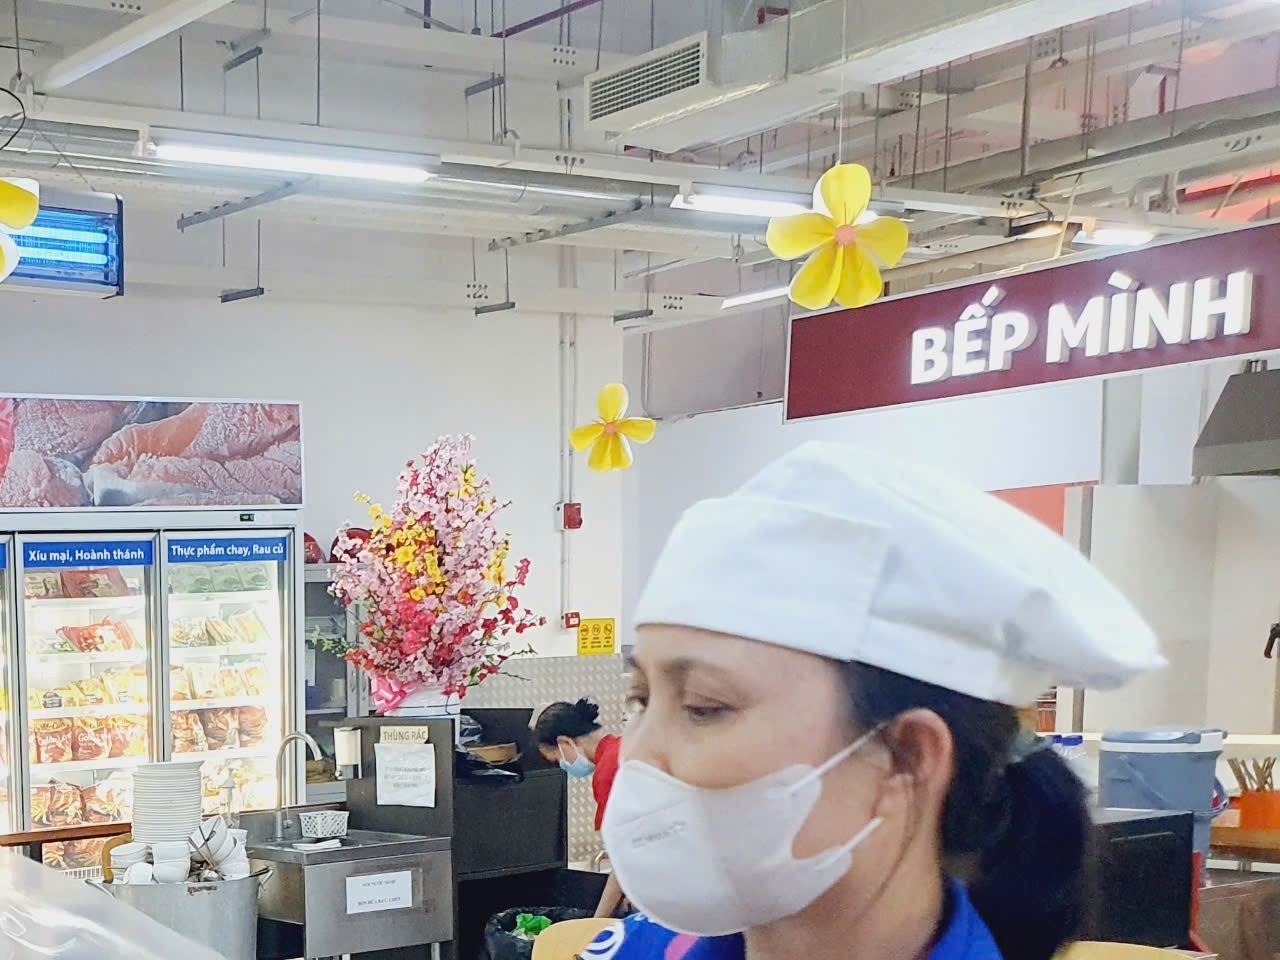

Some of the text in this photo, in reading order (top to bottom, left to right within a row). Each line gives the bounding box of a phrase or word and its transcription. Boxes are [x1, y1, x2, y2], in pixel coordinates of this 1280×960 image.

[911, 270, 1254, 385] BẾP MÌNH
[28, 548, 144, 564] Xíu mại, Hoành thánh
[171, 545, 195, 559] Thực
[226, 544, 251, 557] chay,
[253, 544, 271, 555] Rau
